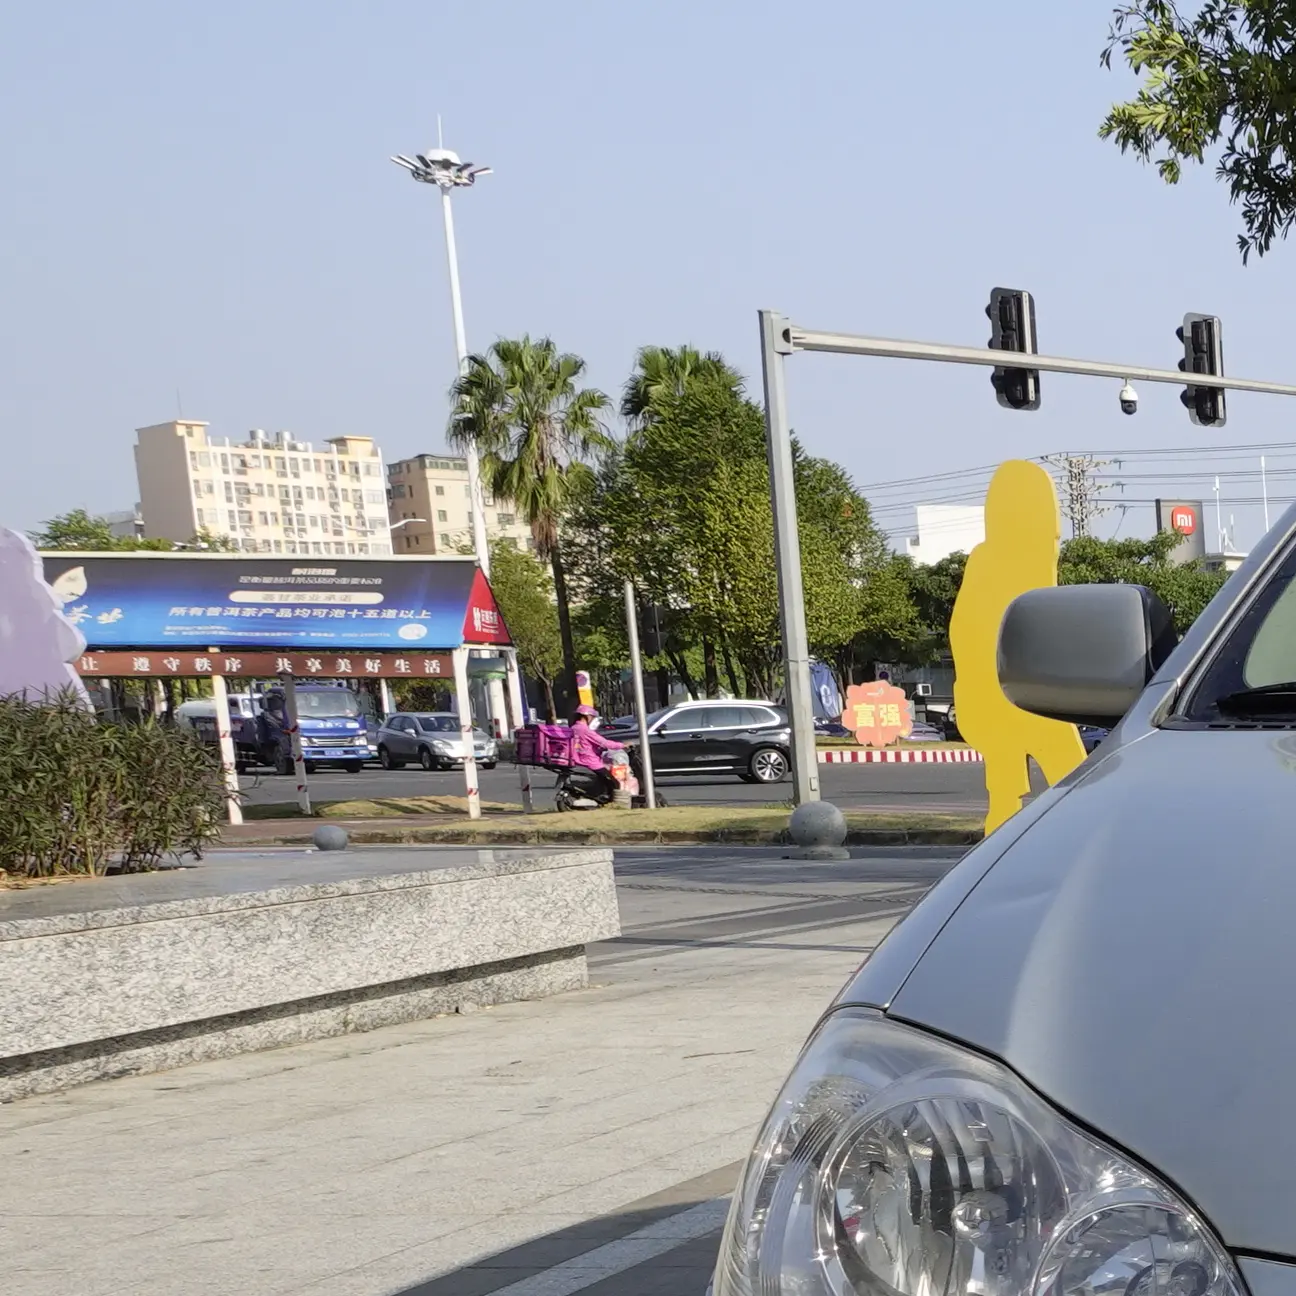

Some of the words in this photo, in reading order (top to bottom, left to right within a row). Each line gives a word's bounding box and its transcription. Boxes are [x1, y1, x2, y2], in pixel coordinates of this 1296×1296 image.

[132, 656, 242, 672] 遵守秩序
[275, 658, 441, 674] 共享美好生活
[853, 703, 901, 727] 富强
